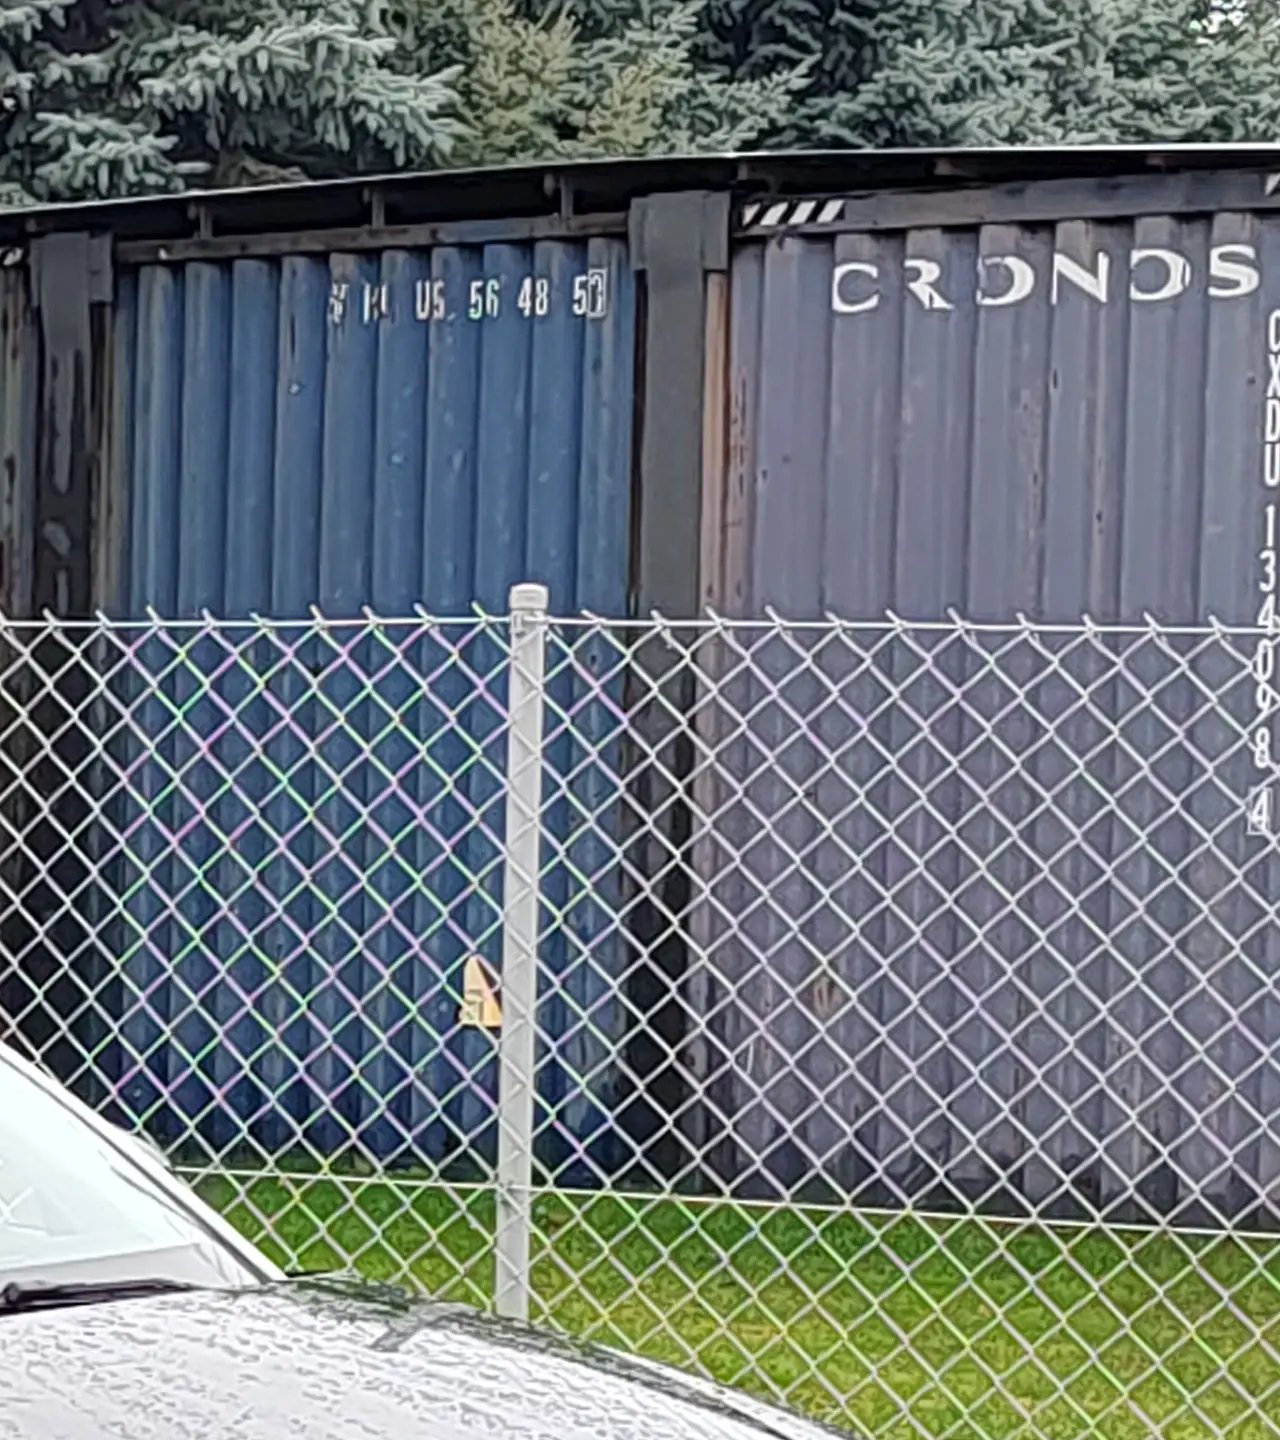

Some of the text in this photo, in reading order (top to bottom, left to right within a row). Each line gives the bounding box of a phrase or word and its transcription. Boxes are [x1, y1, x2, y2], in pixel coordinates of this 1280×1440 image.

[468, 279, 500, 319] 56
[517, 276, 548, 317] 48
[831, 244, 1261, 313] CRONOS
